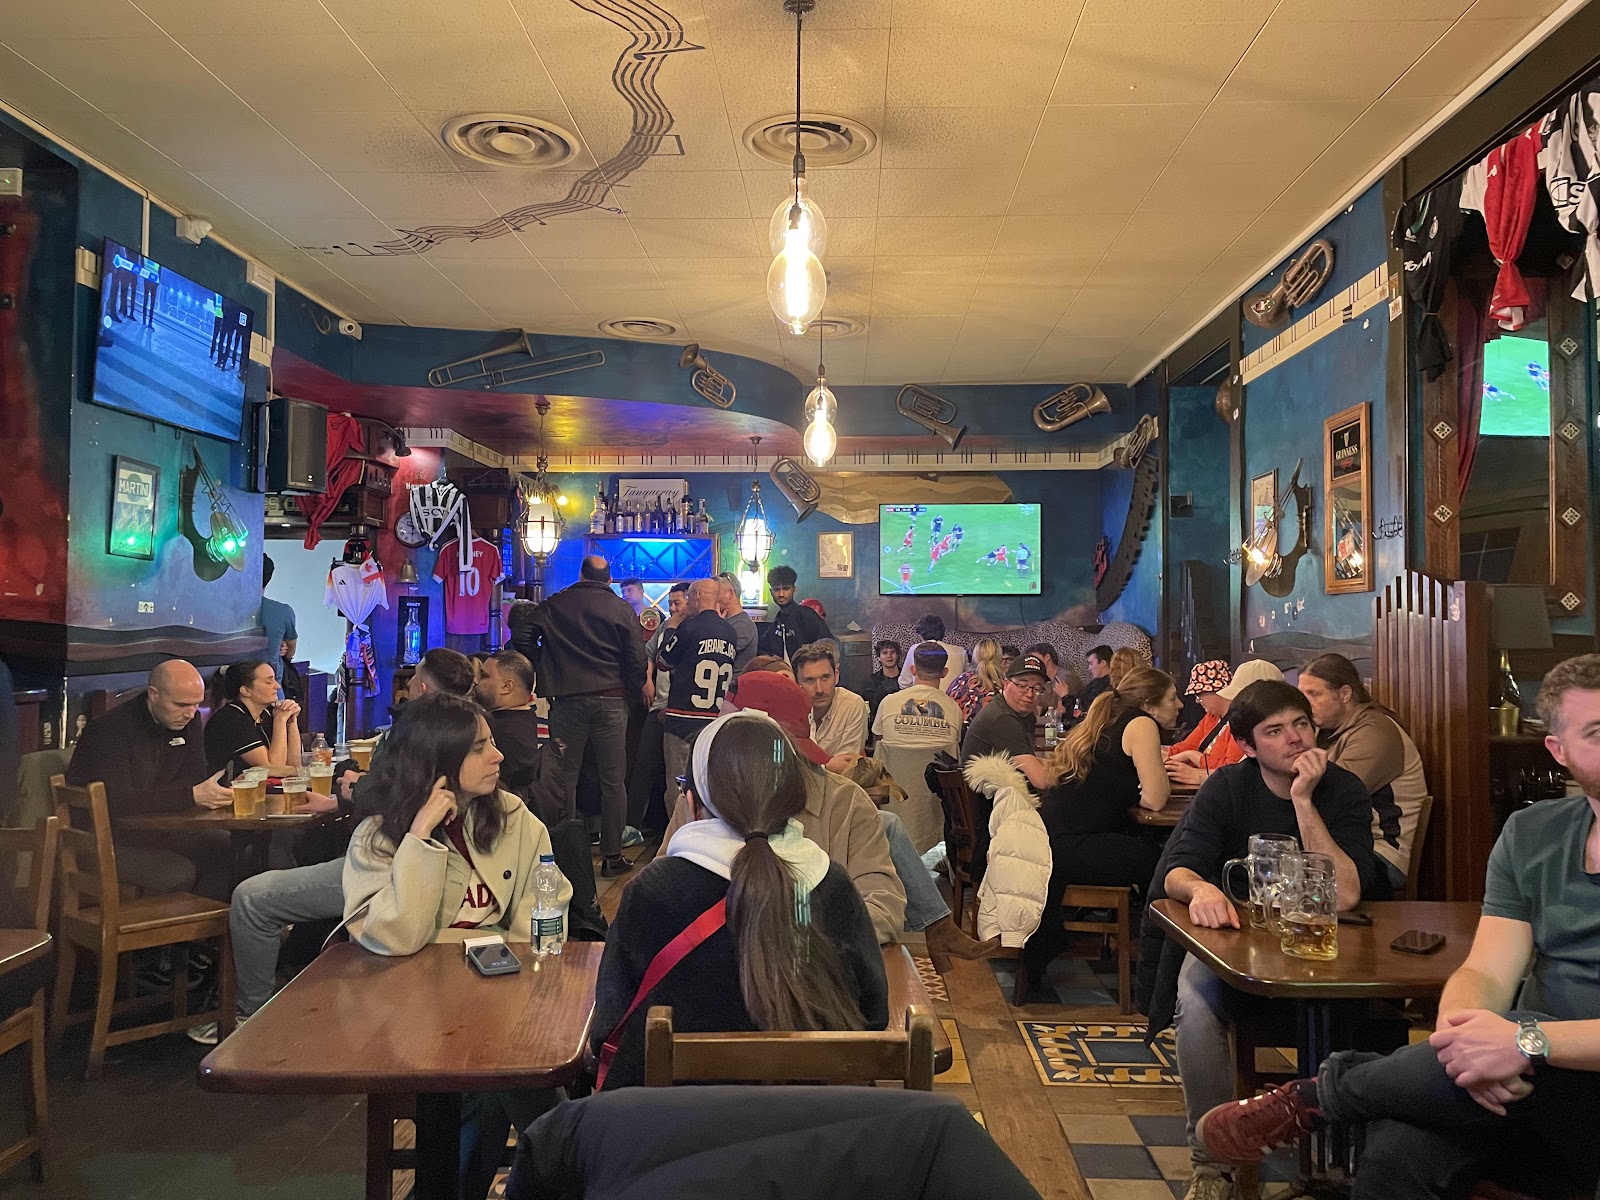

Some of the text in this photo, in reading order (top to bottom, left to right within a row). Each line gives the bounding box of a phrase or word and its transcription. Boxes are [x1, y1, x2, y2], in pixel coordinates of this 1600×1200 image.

[1335, 444, 1358, 460] GUINNESS
[119, 479, 149, 497] MARTINI
[623, 485, 680, 499] Tanqueray
[459, 566, 480, 597] 10
[691, 659, 733, 710] 93
[460, 883, 496, 909] AD
